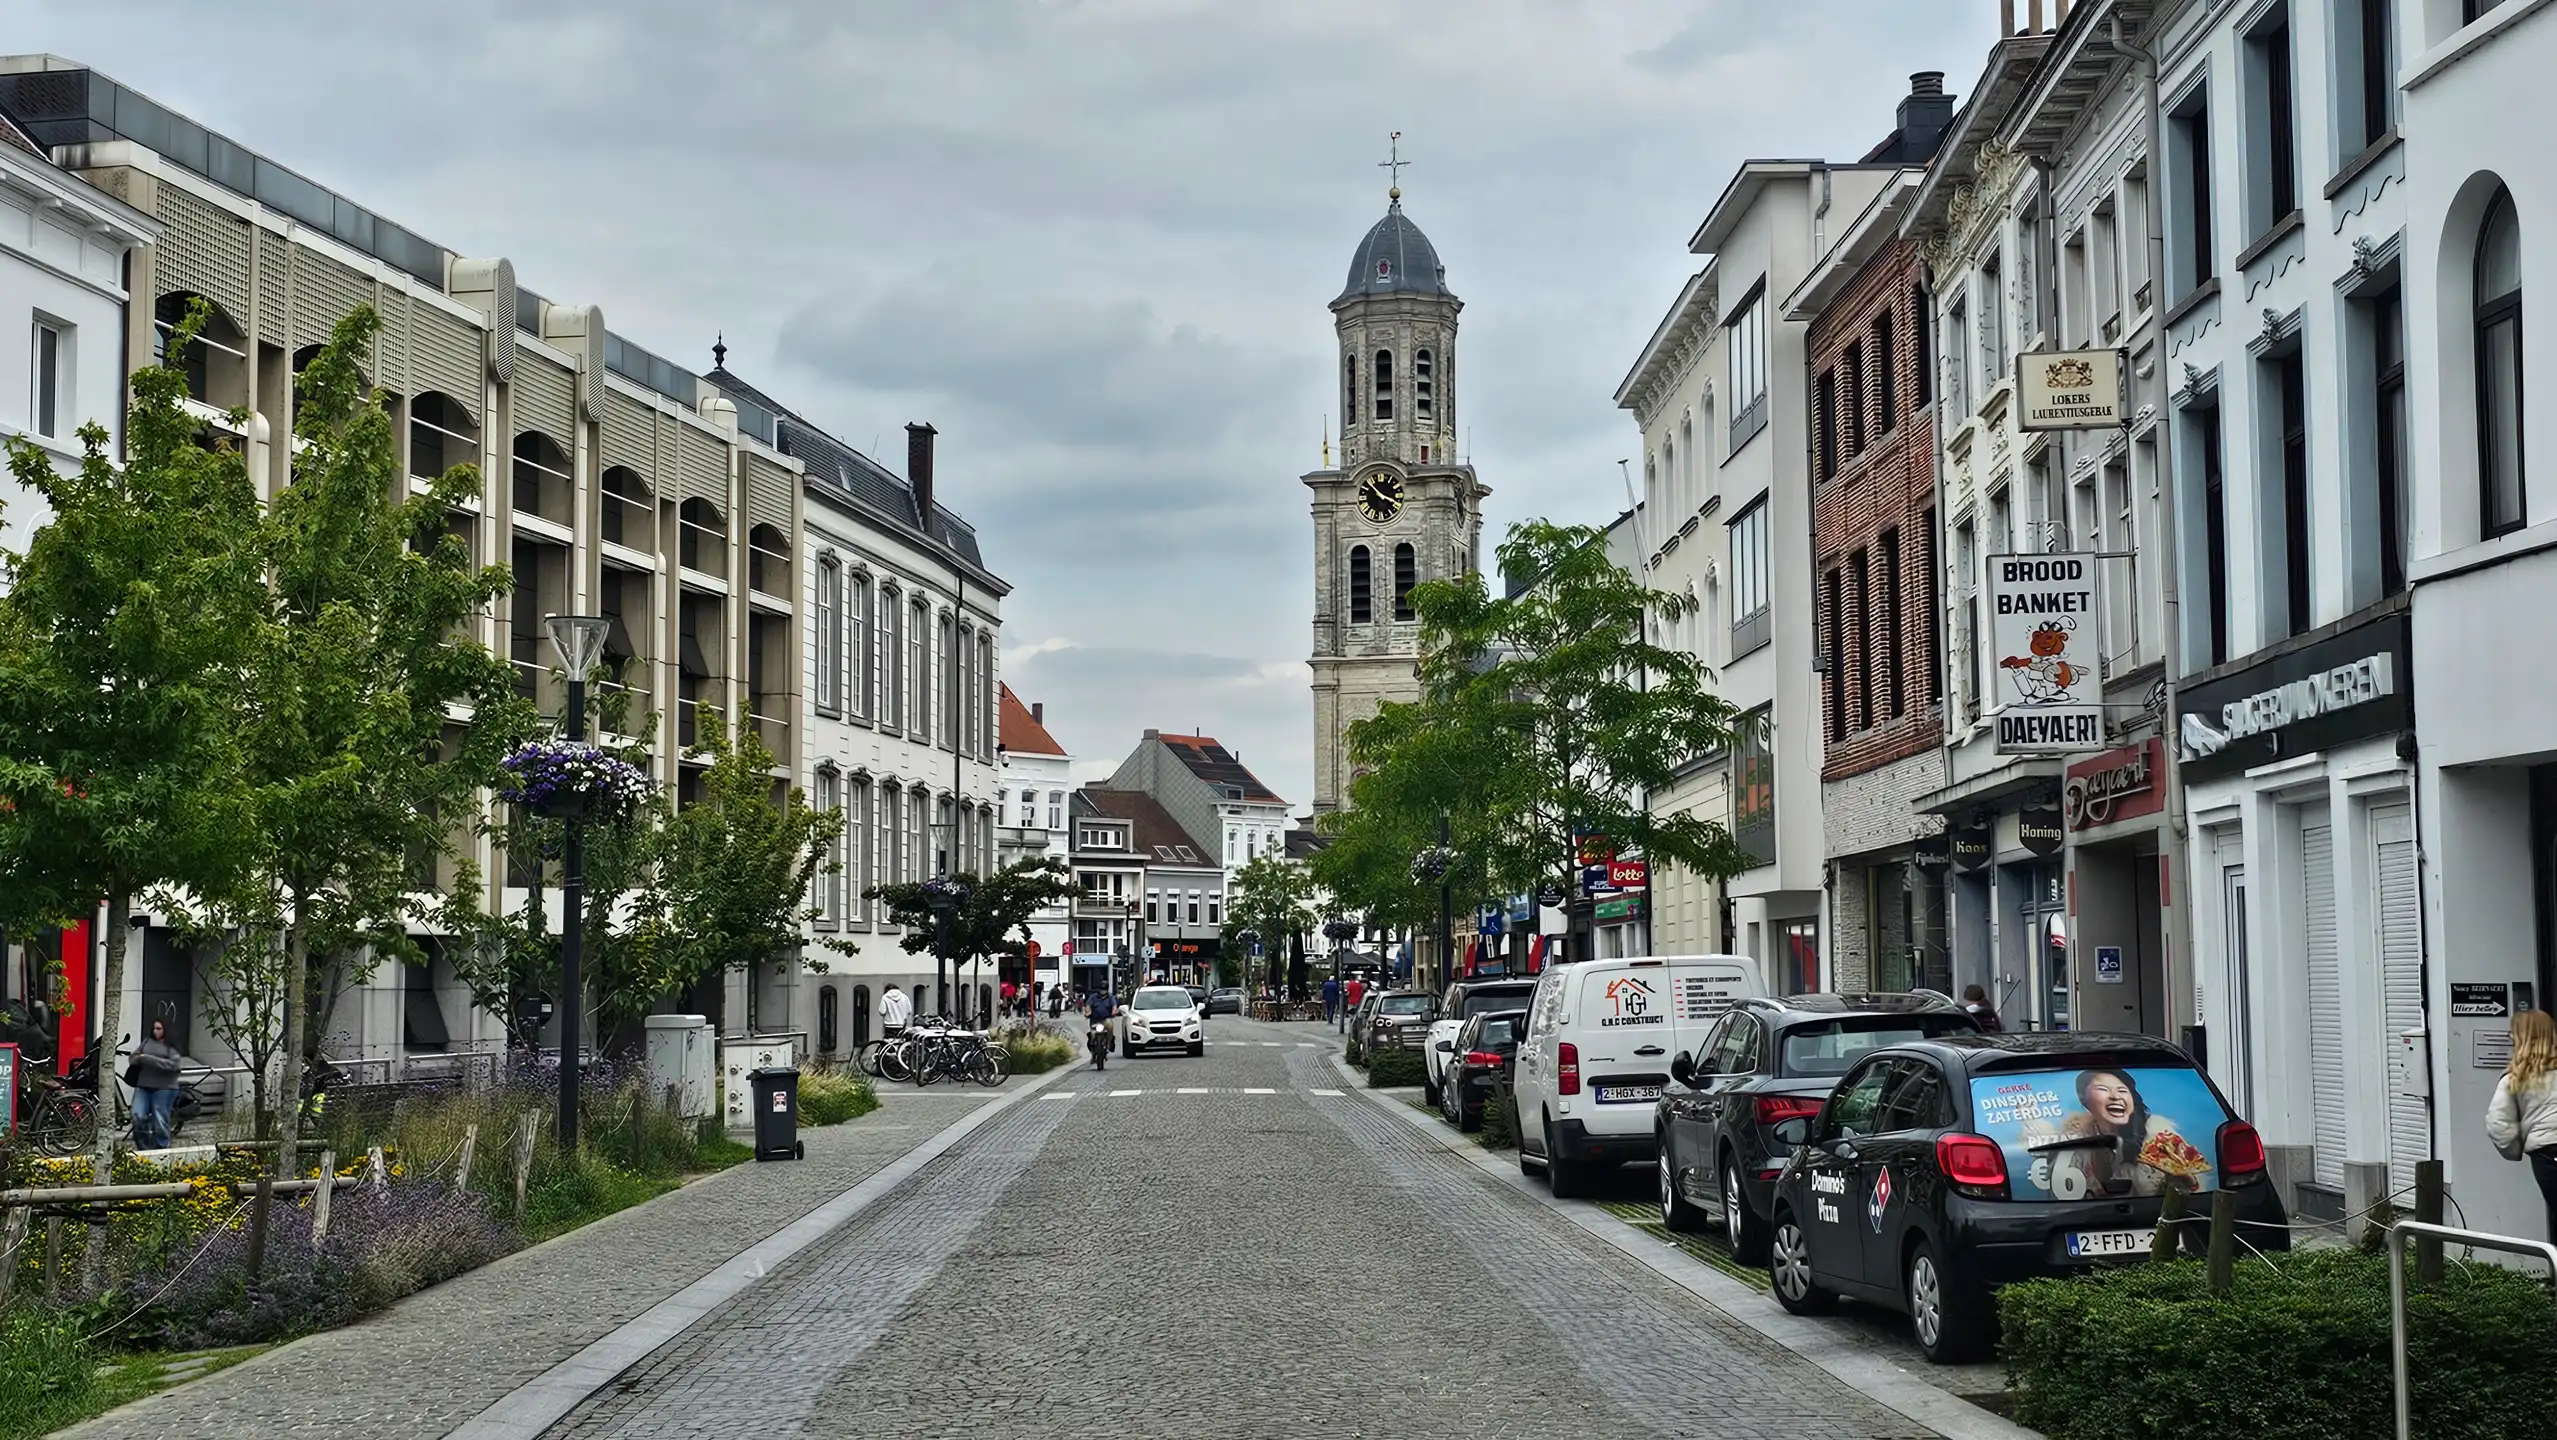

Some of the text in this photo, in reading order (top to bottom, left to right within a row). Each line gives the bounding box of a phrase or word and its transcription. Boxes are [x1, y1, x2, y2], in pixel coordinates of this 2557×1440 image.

[2052, 394, 2090, 405] LOKERS
[2032, 406, 2112, 419] LAURENTIUSGEBAK
[2003, 560, 2082, 582] BROOD
[1997, 592, 2089, 614] BANKET
[2296, 652, 2393, 720] LOKEREN
[2000, 714, 2098, 744] DAEYAERT
[2021, 824, 2061, 841] Honing
[1956, 840, 1987, 853] Kaas
[1613, 867, 1644, 881] Lotto
[1173, 943, 1198, 954] Oange
[1987, 1105, 2062, 1124] ZATERDAG
[1811, 1169, 1845, 1195] Domino's
[1817, 1198, 1839, 1223] Pizza
